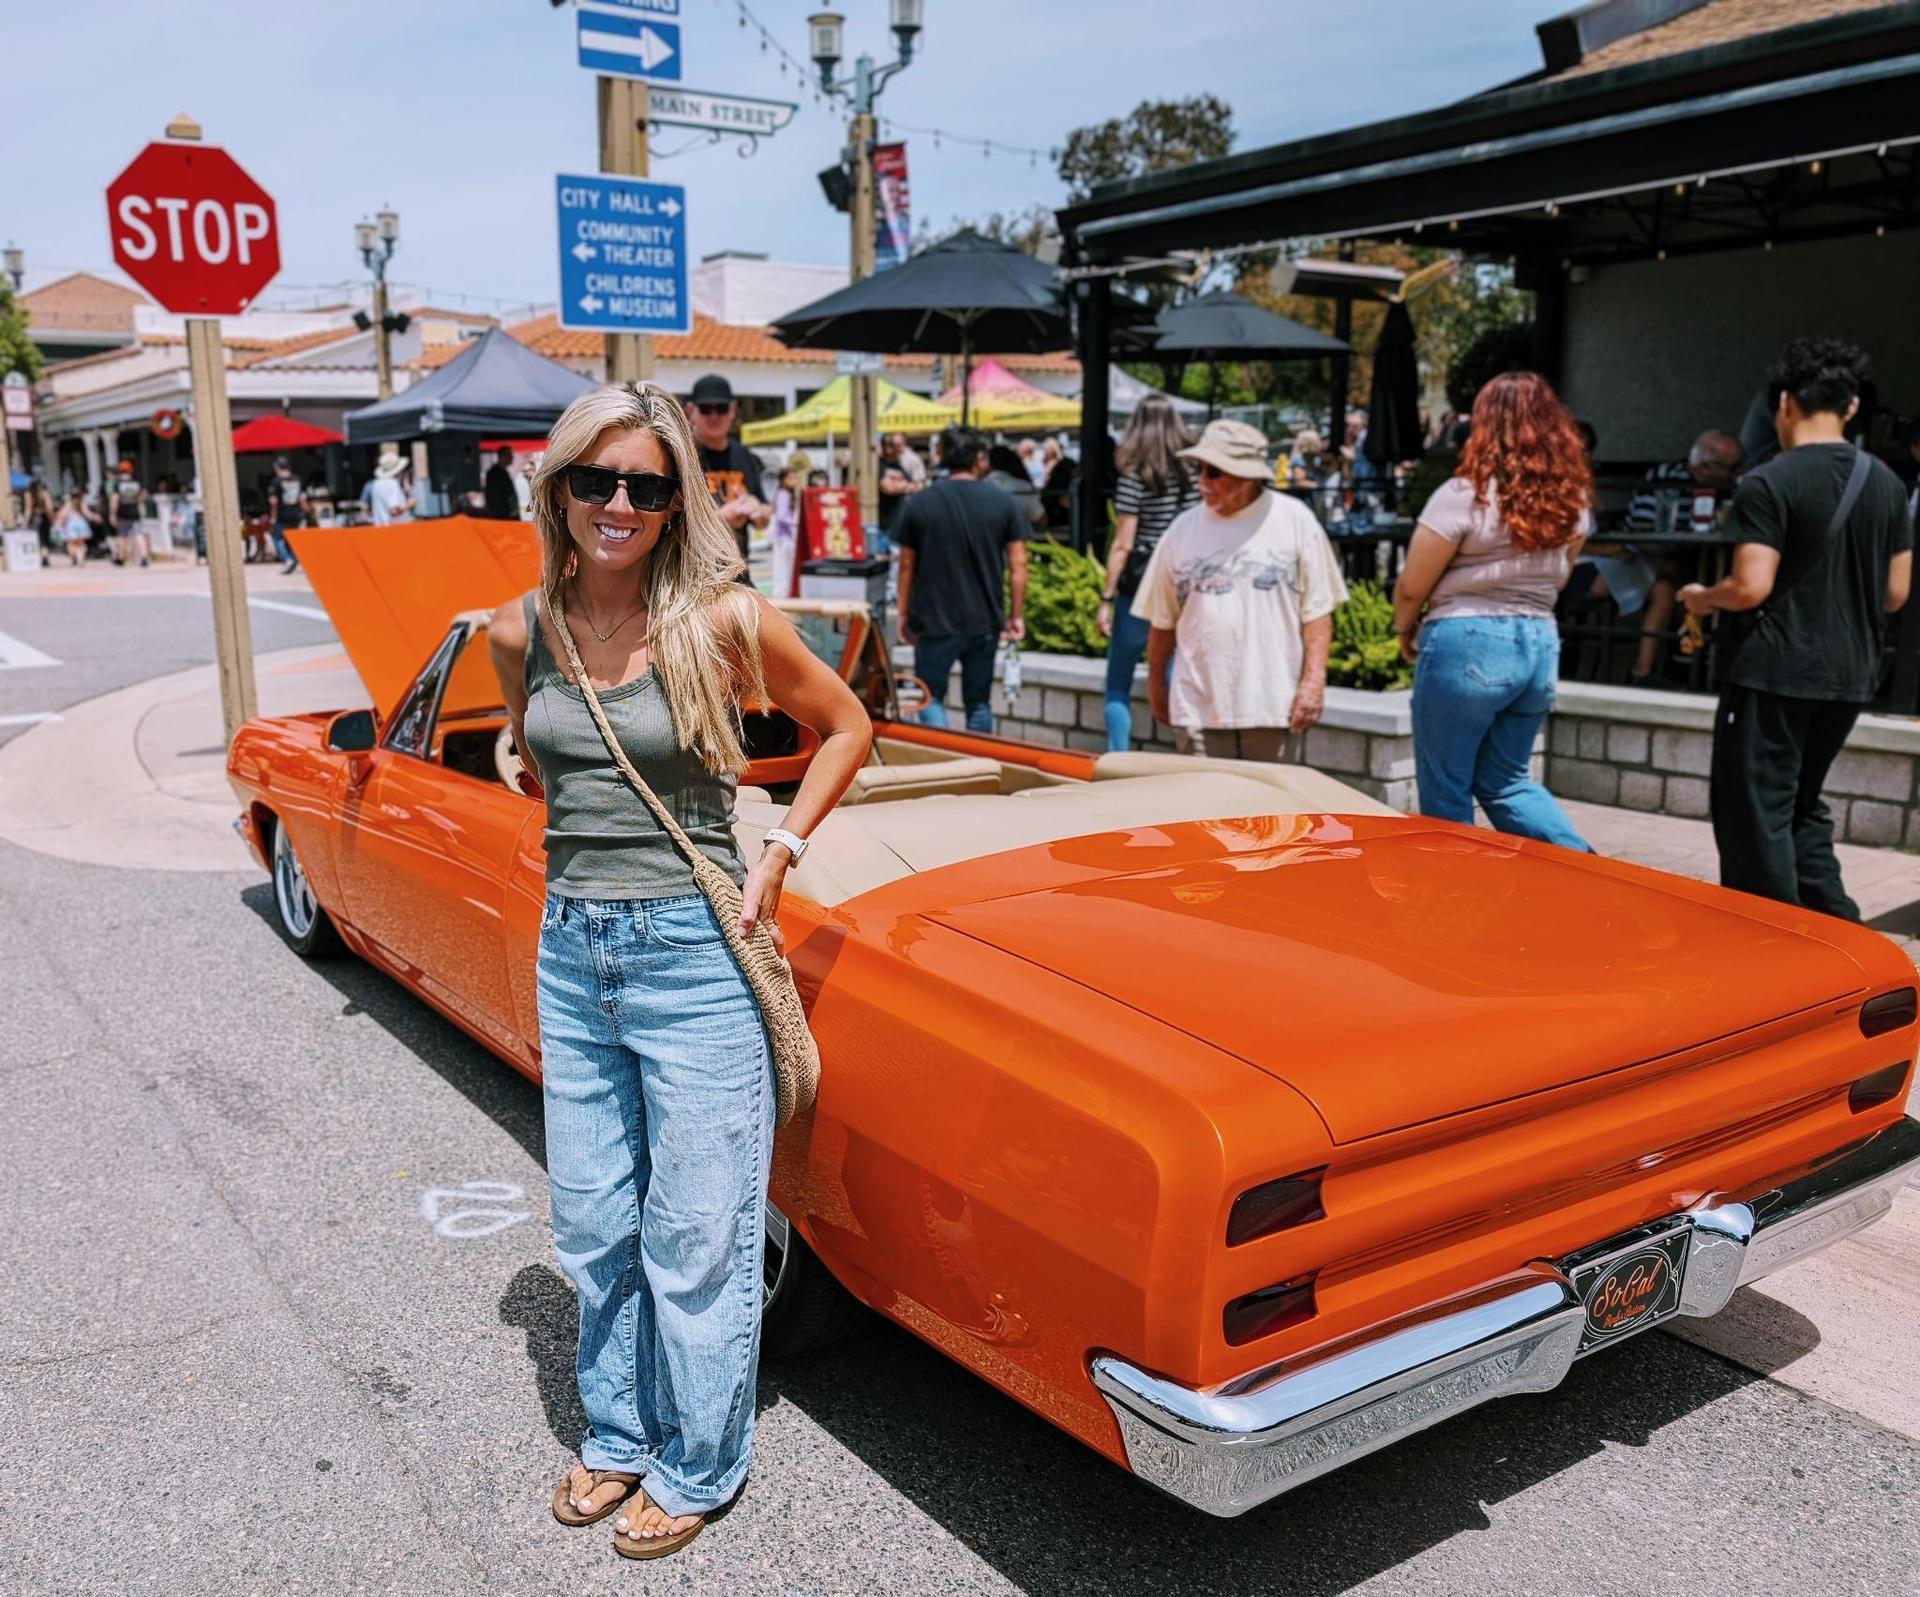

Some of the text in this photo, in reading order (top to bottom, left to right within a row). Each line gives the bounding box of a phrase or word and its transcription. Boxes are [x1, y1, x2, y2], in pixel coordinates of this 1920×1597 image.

[651, 98, 777, 126] MAIN STREET
[560, 187, 654, 215] CITY HALL
[118, 194, 270, 265] STOP
[577, 220, 674, 246] COMMUNITY
[603, 244, 674, 268] THEATER
[585, 273, 676, 297] CHILDRENS
[608, 297, 677, 318] MUSEUM
